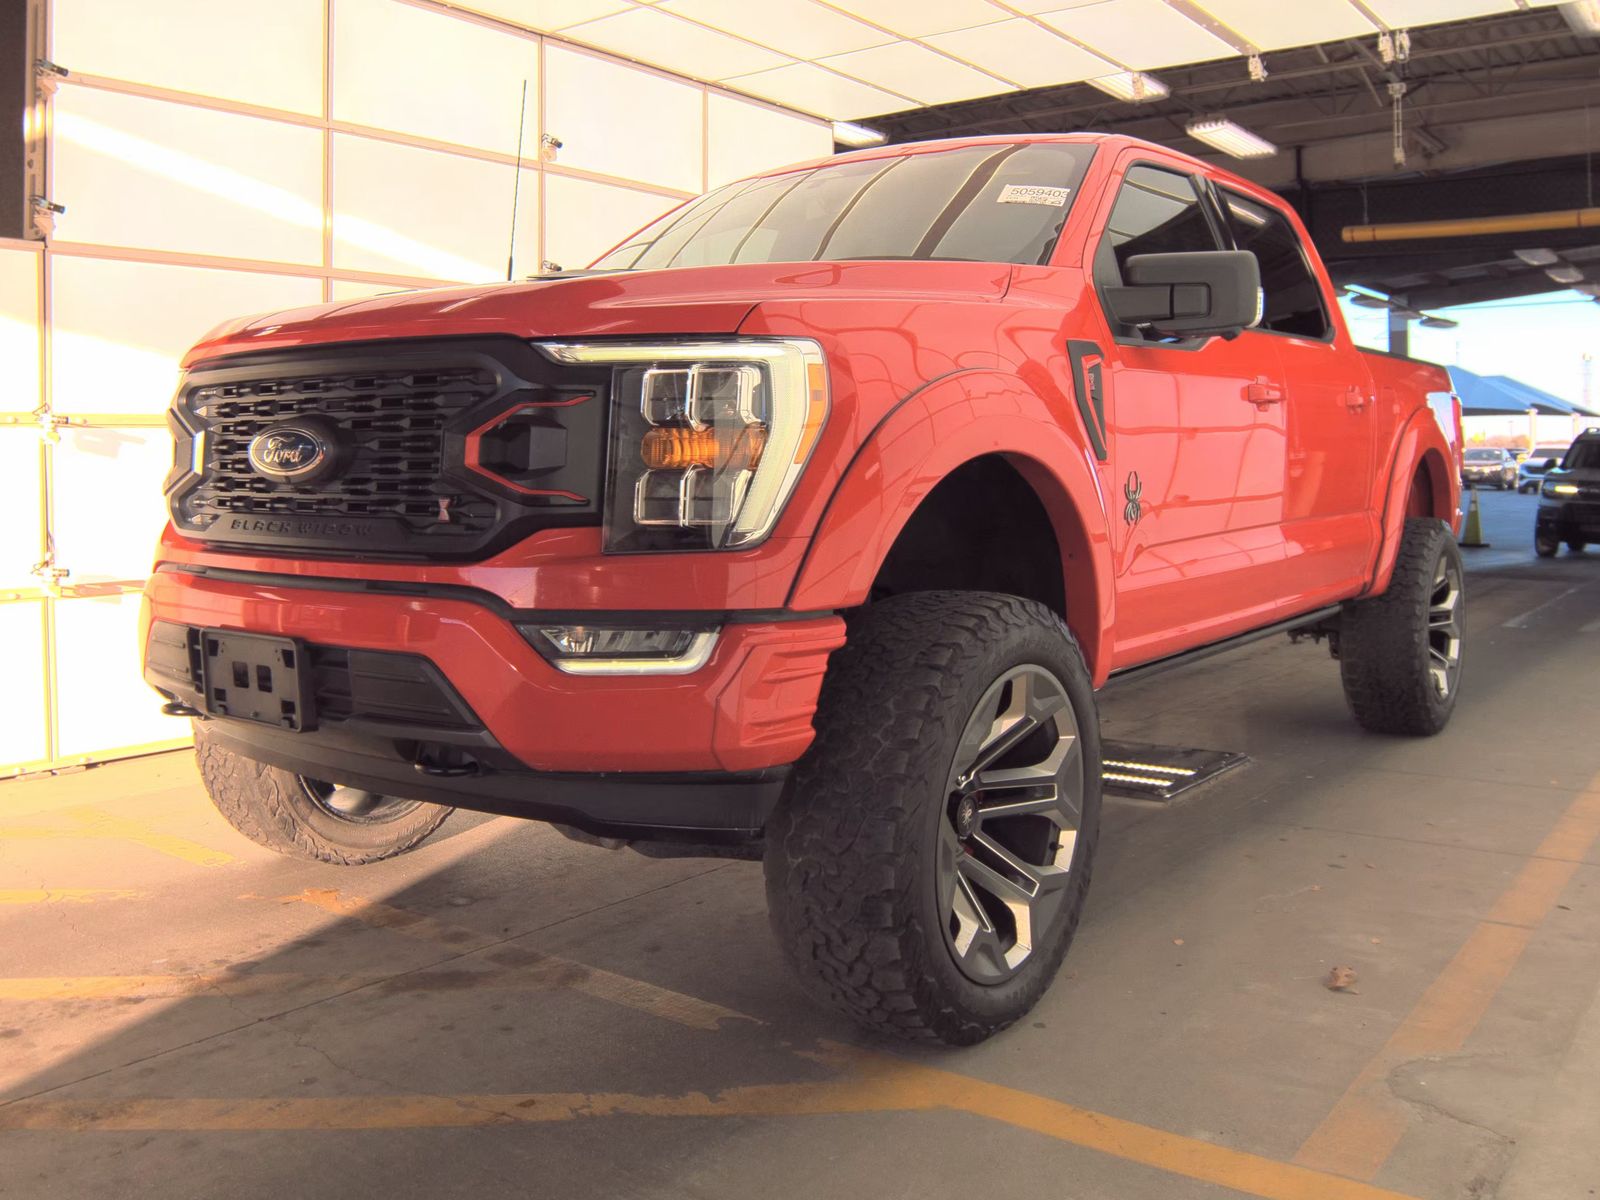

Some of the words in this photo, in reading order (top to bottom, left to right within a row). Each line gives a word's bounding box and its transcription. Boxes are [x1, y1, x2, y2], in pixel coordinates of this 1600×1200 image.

[263, 436, 312, 463] Ford
[230, 518, 292, 533] BLACK
[298, 521, 373, 537] WIDOW
